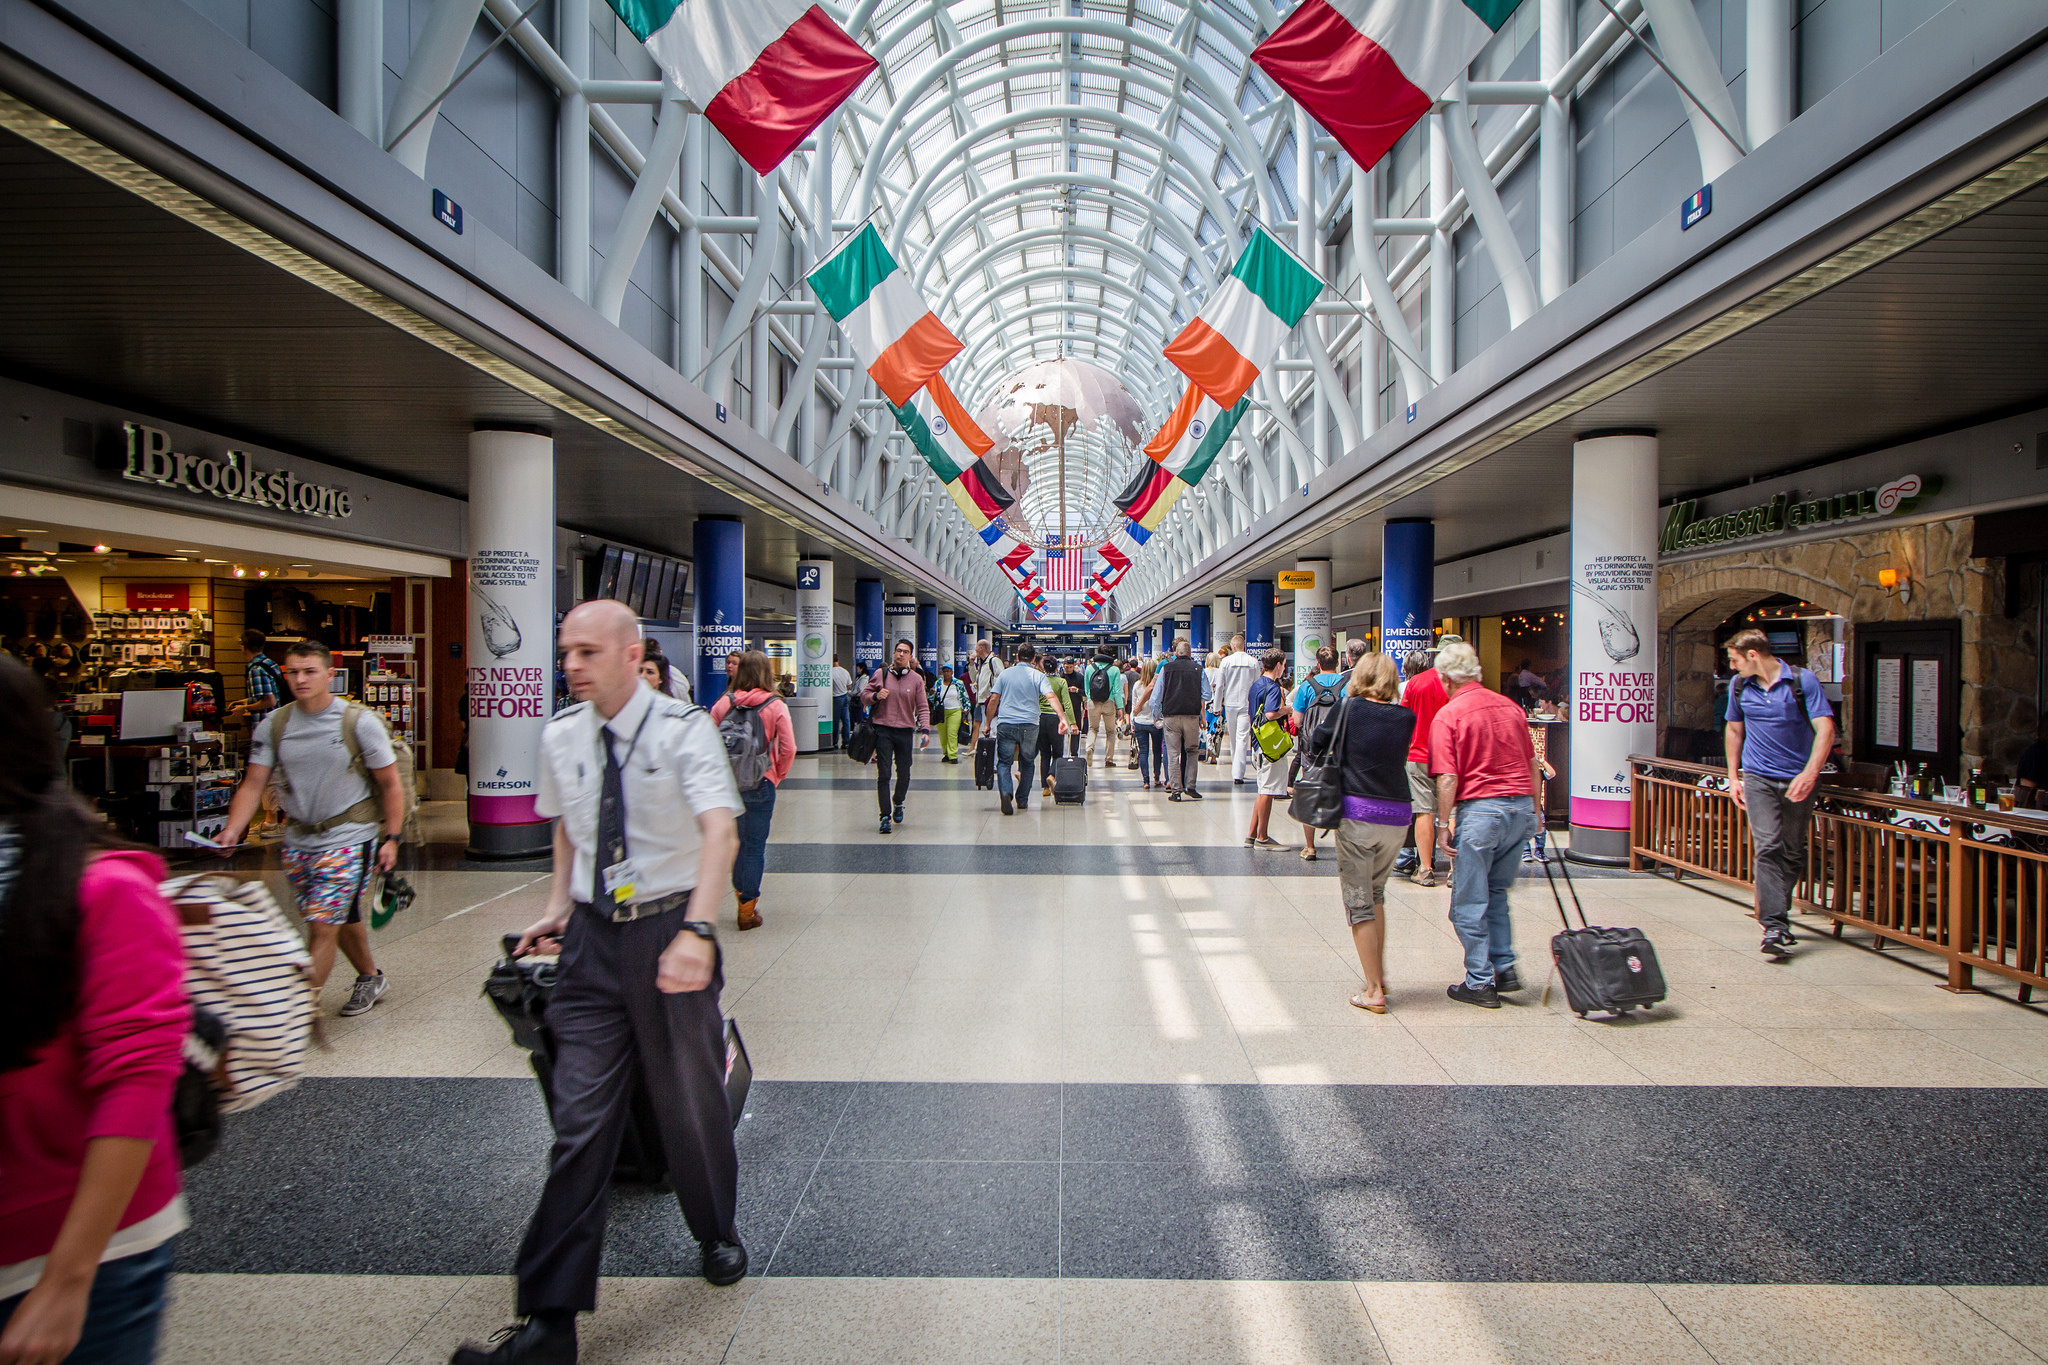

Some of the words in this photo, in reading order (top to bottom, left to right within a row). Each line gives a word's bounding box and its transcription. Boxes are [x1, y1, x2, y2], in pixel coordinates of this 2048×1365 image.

[441, 211, 456, 227] ITALY
[1687, 207, 1703, 224] ITALY
[138, 423, 353, 519] Brookstone
[1658, 495, 1779, 552] Macaroni
[1788, 494, 1873, 527] GRILL
[493, 550, 522, 558] PROTECT
[512, 565, 538, 573] INSTANT
[1584, 563, 1603, 571] CITY'S
[137, 591, 175, 599] Brookstone
[697, 625, 742, 633] EMERSON
[1385, 628, 1431, 637] EMERSON
[696, 636, 742, 647] CONSIDER
[1385, 639, 1432, 650] CONSIDER
[809, 663, 830, 671] NEVER
[1297, 665, 1307, 674] IT'S
[470, 667, 487, 682] IT'S
[490, 667, 543, 682] NEVER
[1579, 672, 1604, 686] IT'S
[1609, 672, 1655, 687] NEVER
[799, 678, 831, 688] BEFORE
[470, 683, 496, 697] BEEN
[501, 683, 543, 697] DONE
[1579, 687, 1615, 701] BEEN
[1620, 688, 1655, 701] DONE
[470, 697, 544, 719] BEFORE
[1579, 702, 1655, 723] BEFORE
[477, 780, 531, 790] EMERSON
[1590, 784, 1631, 794] EMERS
